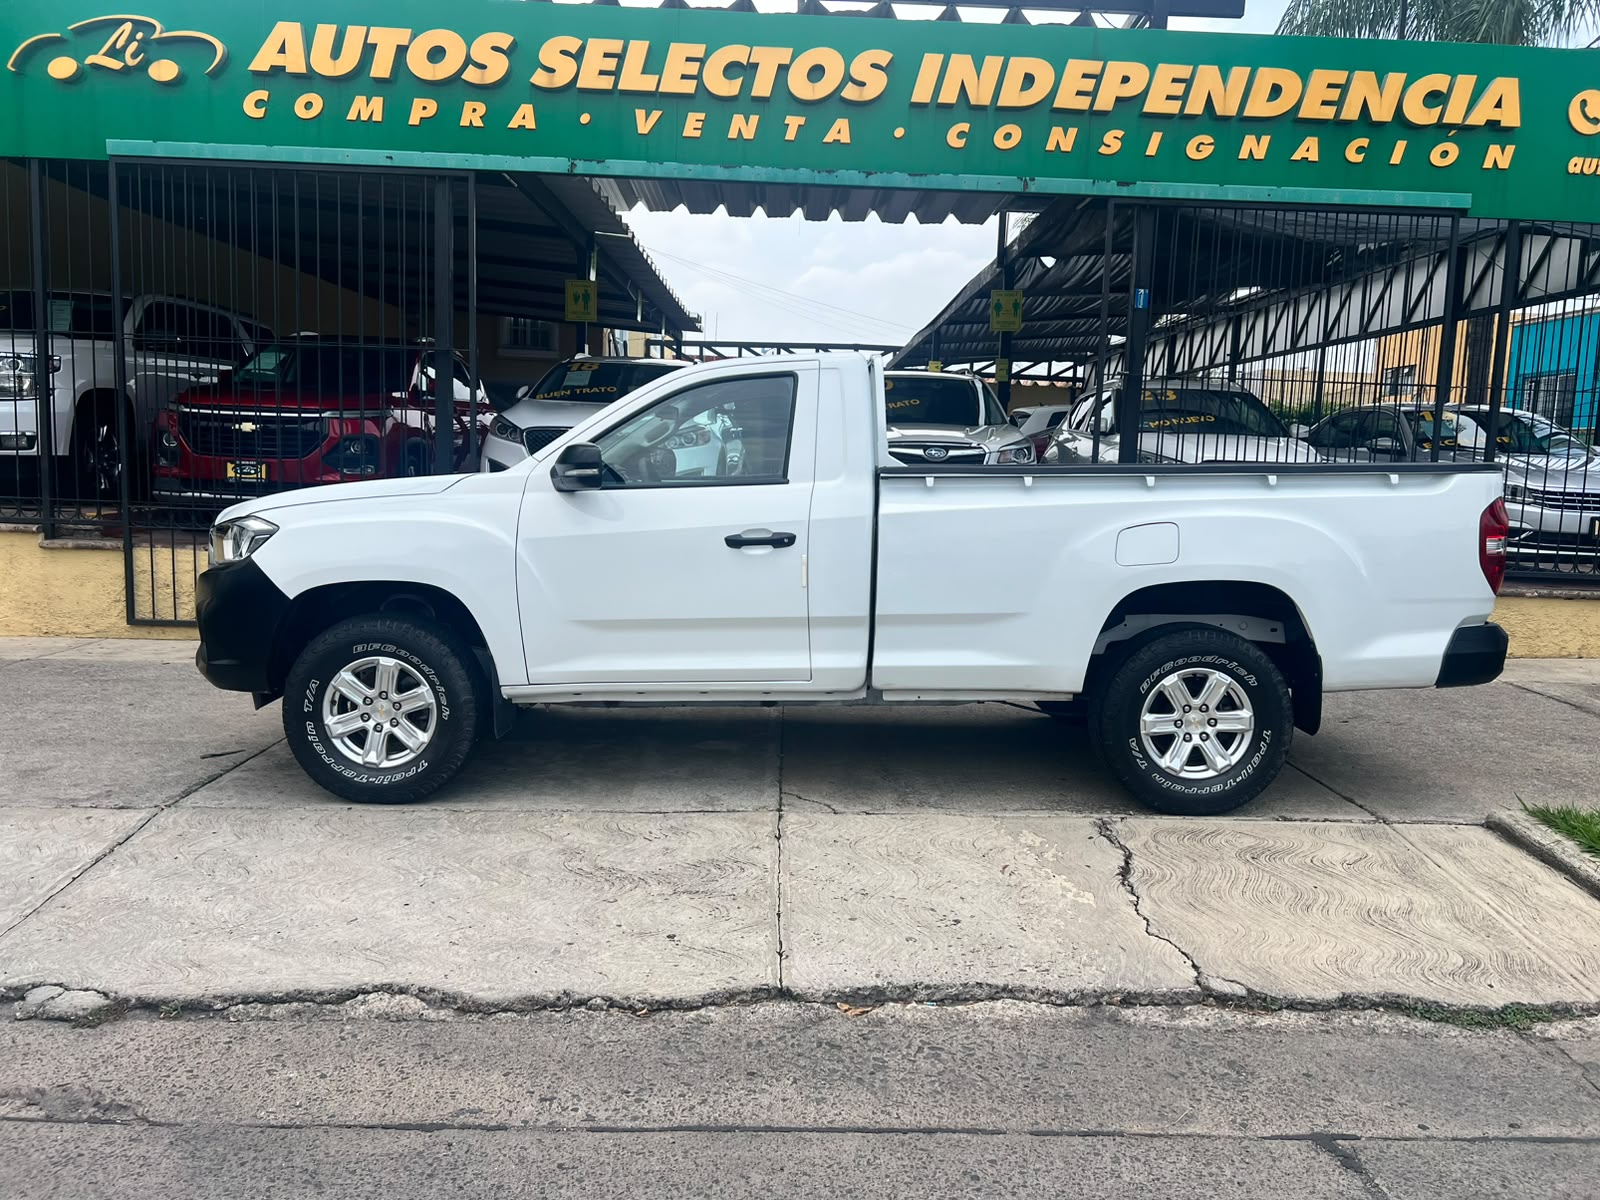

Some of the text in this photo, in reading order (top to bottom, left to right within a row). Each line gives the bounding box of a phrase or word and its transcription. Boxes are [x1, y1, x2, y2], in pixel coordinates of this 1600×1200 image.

[248, 20, 1522, 128] AUTOS SELECTOS INDEPENDENCIA
[242, 90, 1517, 170] COMPRA VENTA CONSIGNACIÓN
[535, 386, 617, 400] BUEN TRATO
